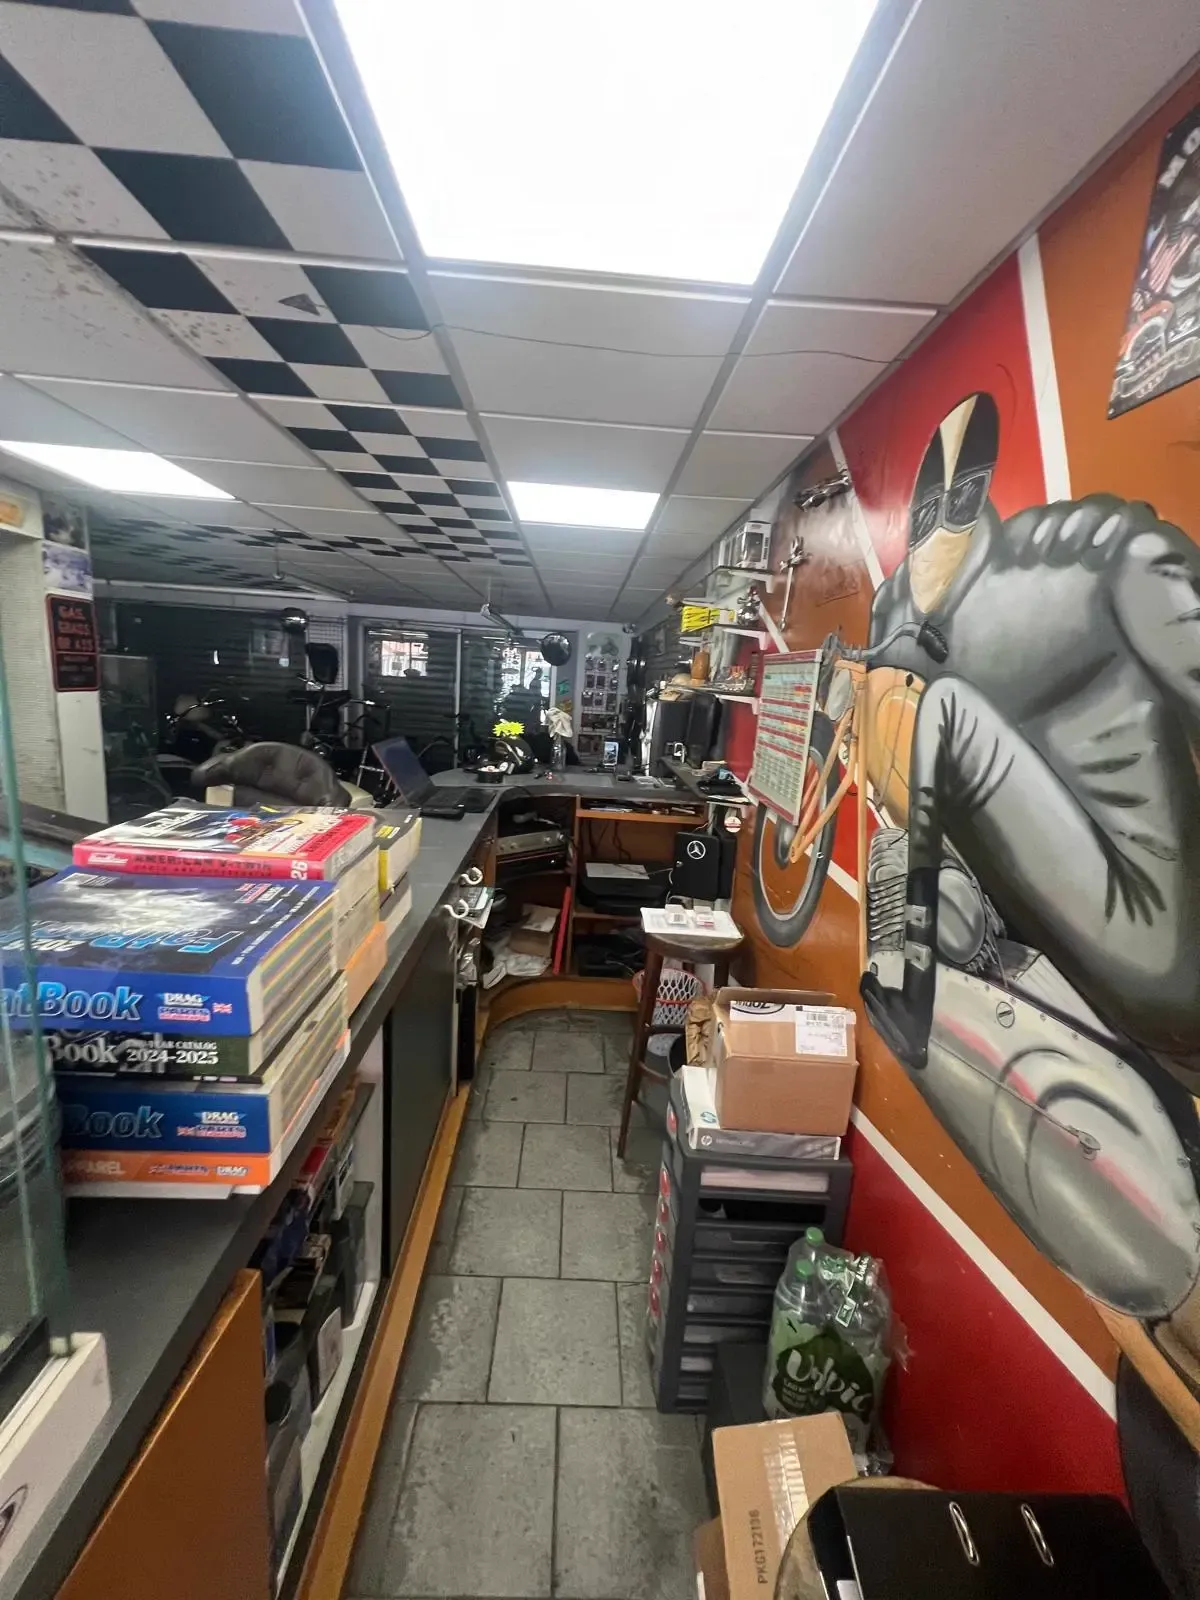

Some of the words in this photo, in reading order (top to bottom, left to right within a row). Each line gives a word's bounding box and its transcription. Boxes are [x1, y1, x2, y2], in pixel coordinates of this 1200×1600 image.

[135, 853, 213, 867] AMERICAN
[175, 1040, 218, 1050] CATALOG
[126, 1049, 219, 1065] 2024-2025
[201, 1111, 240, 1122] DRAG
